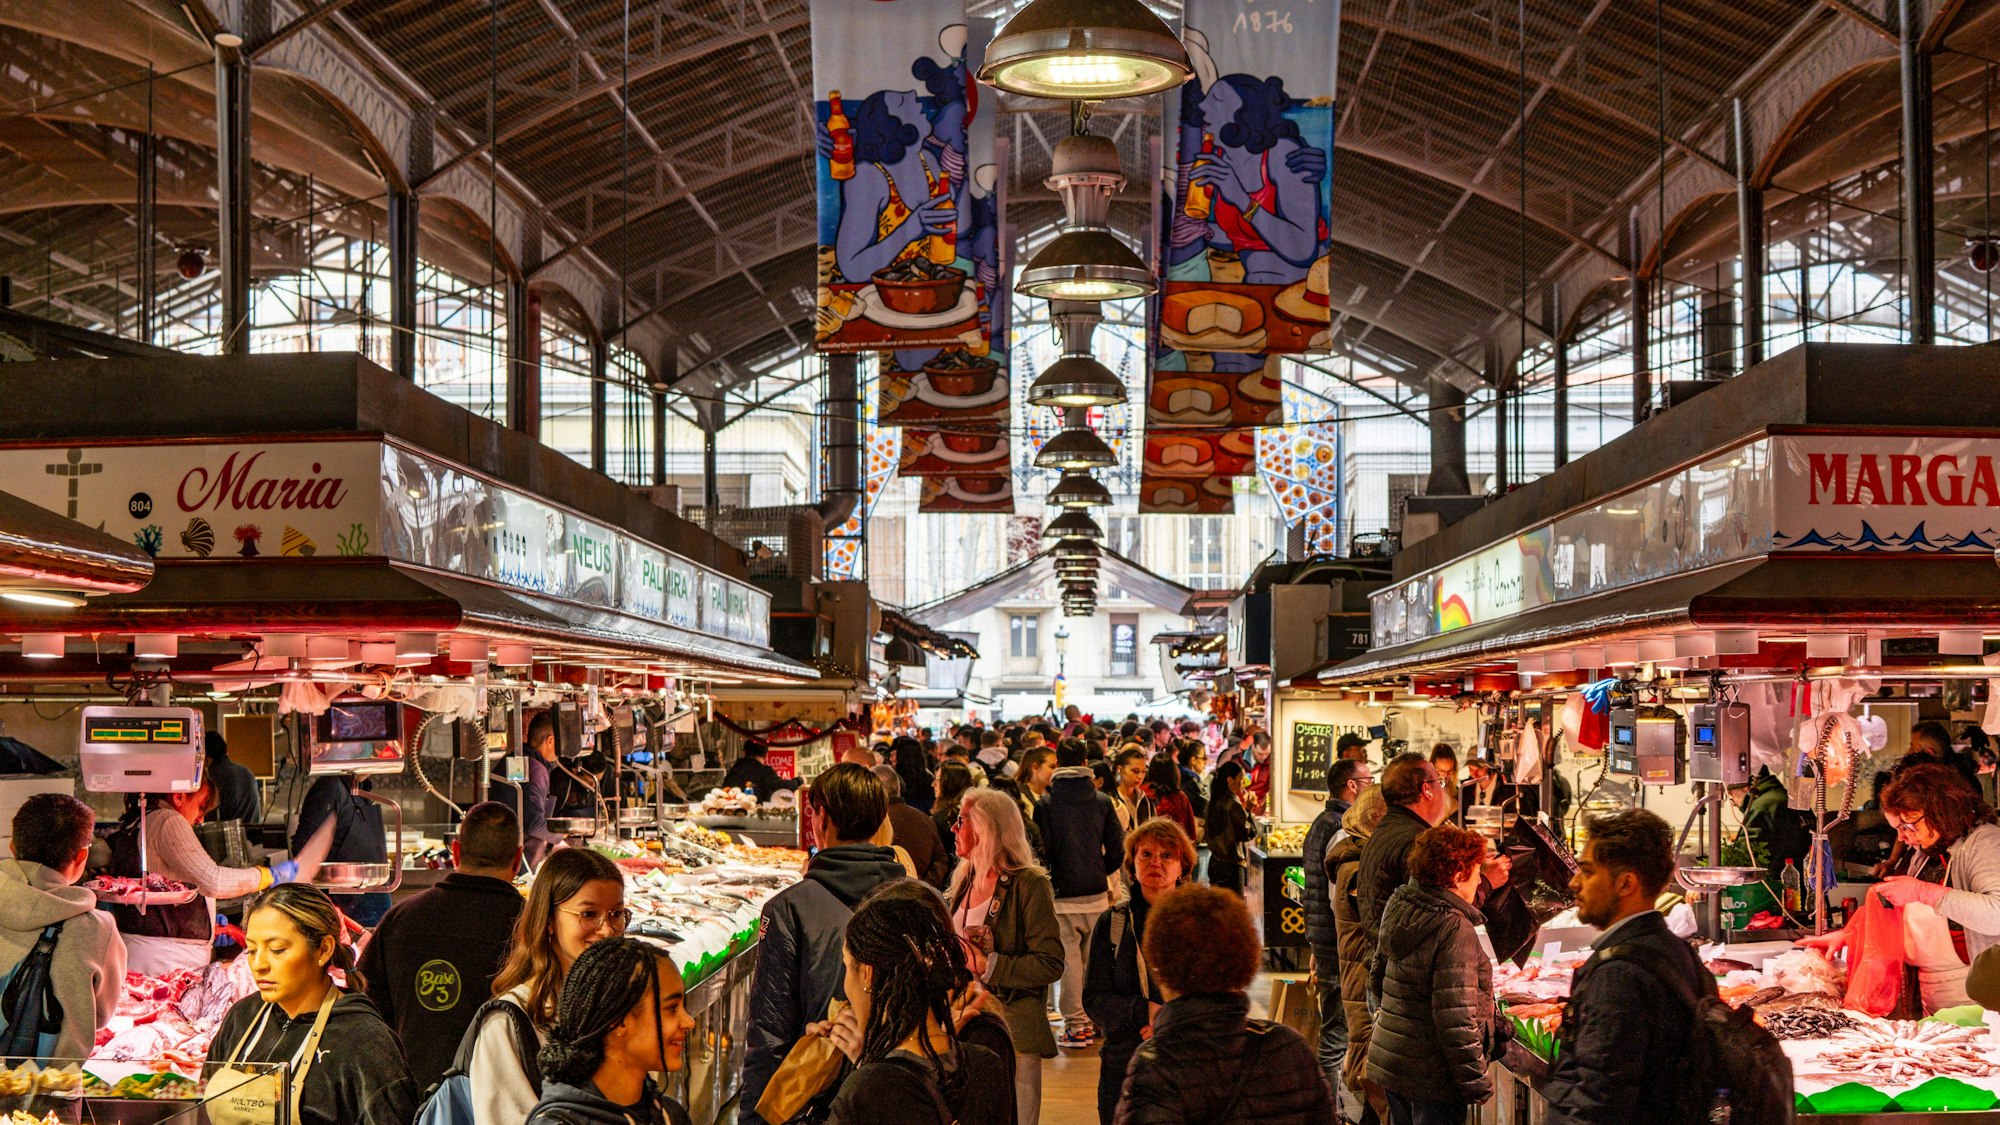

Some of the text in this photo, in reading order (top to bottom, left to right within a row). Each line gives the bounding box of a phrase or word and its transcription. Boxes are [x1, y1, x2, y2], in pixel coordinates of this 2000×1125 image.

[1232, 10, 1293, 34] 1876
[177, 451, 348, 512] Maria
[1808, 453, 2000, 507] MARGA
[130, 500, 151, 512] 804
[573, 533, 612, 574] NEUS
[642, 559, 688, 600] PALMIRA
[712, 585, 744, 617] PALMIRA
[1352, 633, 1368, 645] 781
[1296, 724, 1332, 736] OYSTER
[420, 970, 455, 995] Base
[436, 986, 449, 1003] 3
